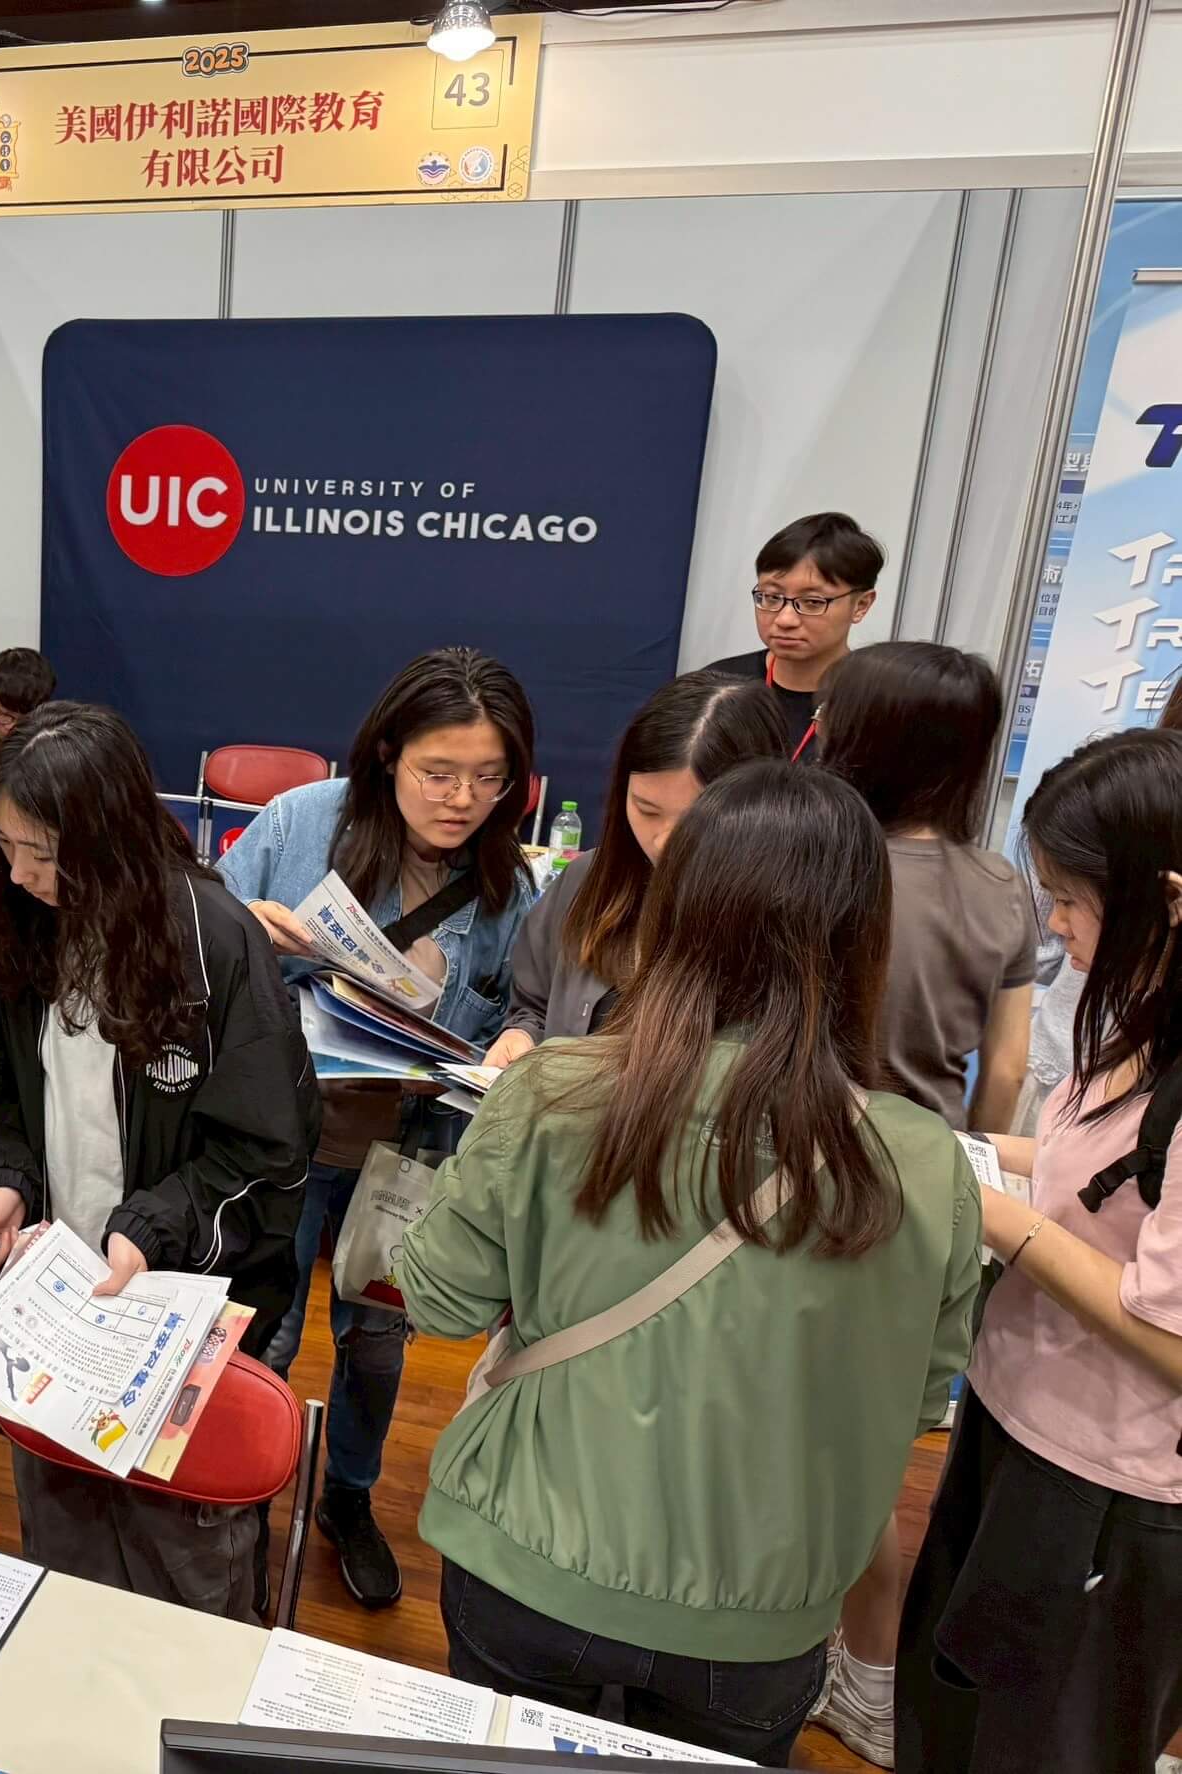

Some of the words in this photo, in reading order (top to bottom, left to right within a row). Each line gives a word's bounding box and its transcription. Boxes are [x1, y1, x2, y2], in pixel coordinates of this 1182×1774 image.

[185, 46, 246, 73] 2025
[444, 72, 490, 106] 43
[55, 90, 385, 144] 美國伊利諾國際教育
[141, 144, 284, 188] 有限公司
[119, 475, 228, 528] UIC
[255, 478, 424, 497] UNIVERSITY
[440, 481, 476, 499] OF
[253, 506, 404, 536] ILLINOIS
[417, 511, 597, 543] CHICAGO
[146, 1053, 198, 1084] PALLADIUM
